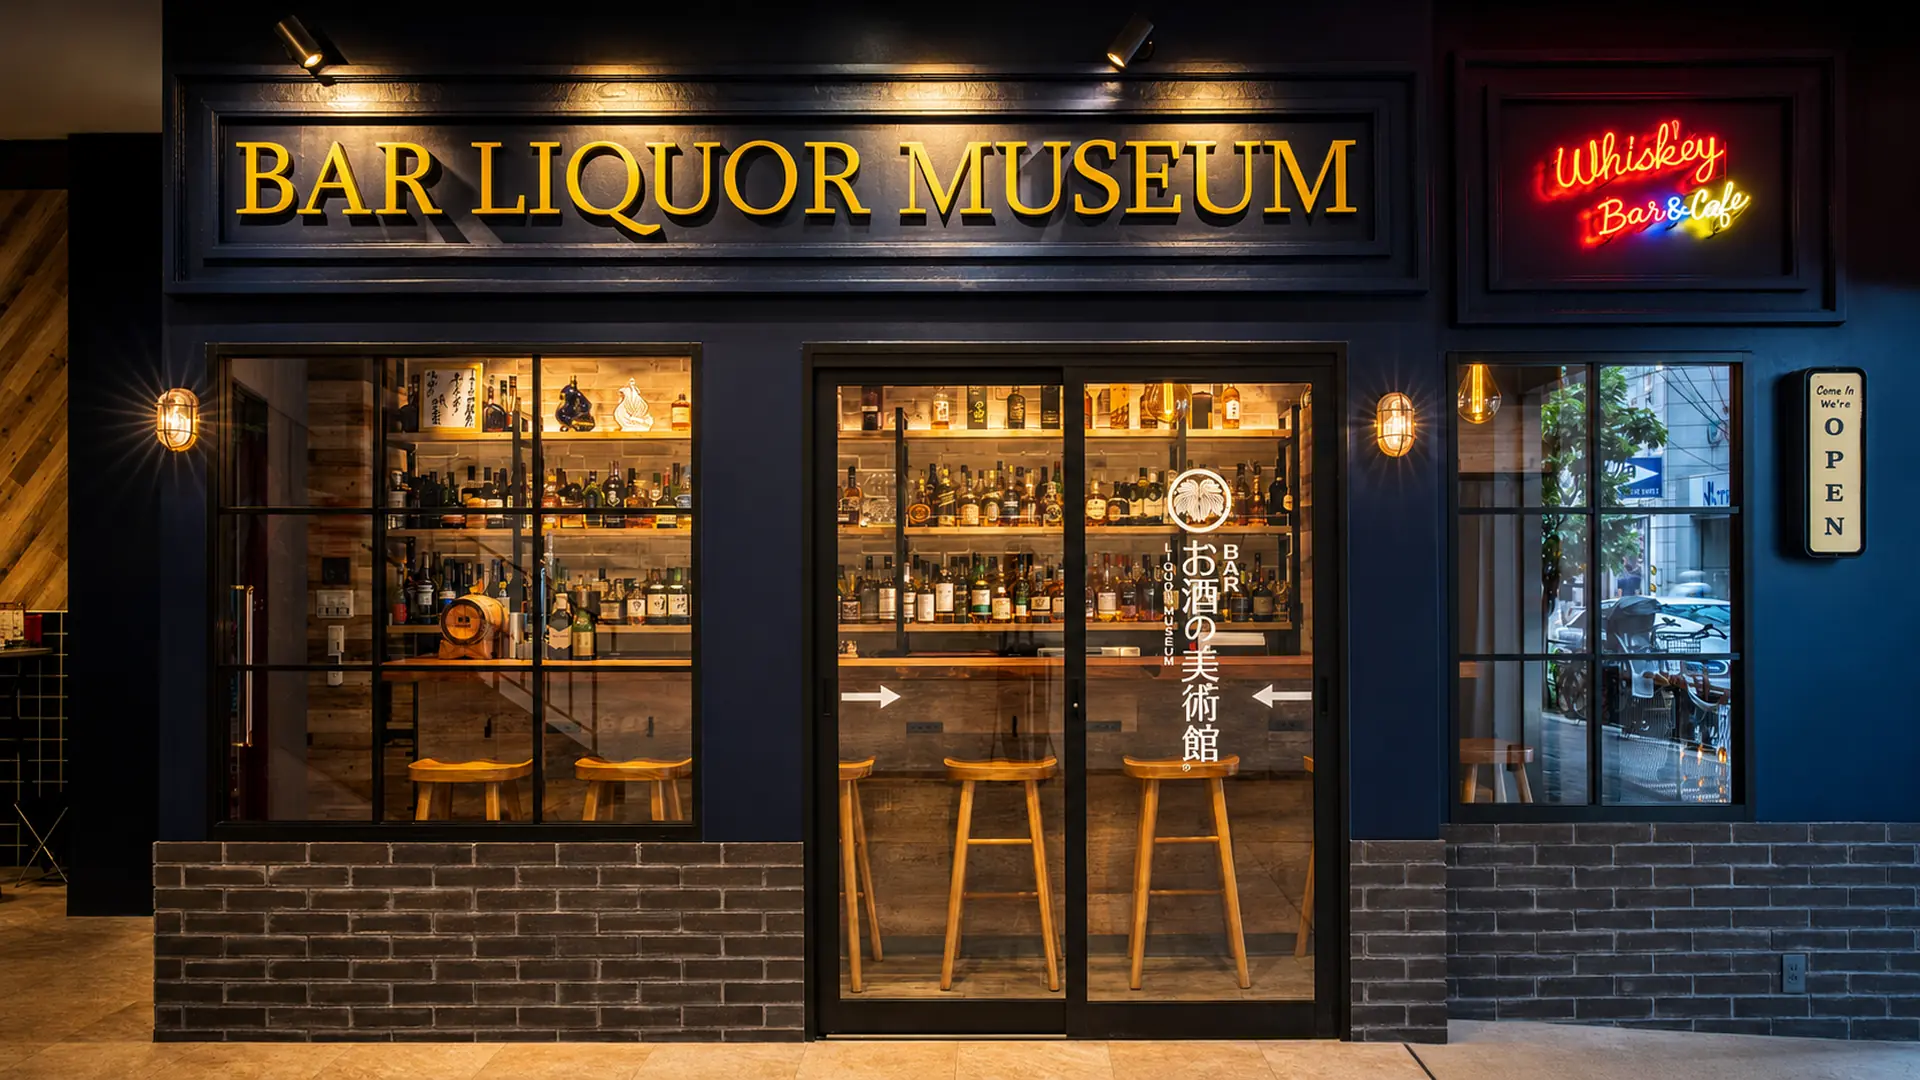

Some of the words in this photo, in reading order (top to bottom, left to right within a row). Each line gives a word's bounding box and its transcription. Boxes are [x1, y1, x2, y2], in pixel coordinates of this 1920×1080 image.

[235, 140, 443, 215] BAR
[471, 140, 872, 237] LIQUOR
[899, 138, 1358, 216] MUSEUM
[1816, 385, 1842, 396] Come
[1844, 385, 1855, 396] In
[1820, 399, 1851, 409] We're
[1824, 417, 1845, 536] OPEN
[1223, 543, 1239, 593] BAR
[1163, 606, 1174, 666] MUSEUM
[1181, 539, 1220, 762] お酒の美術館
